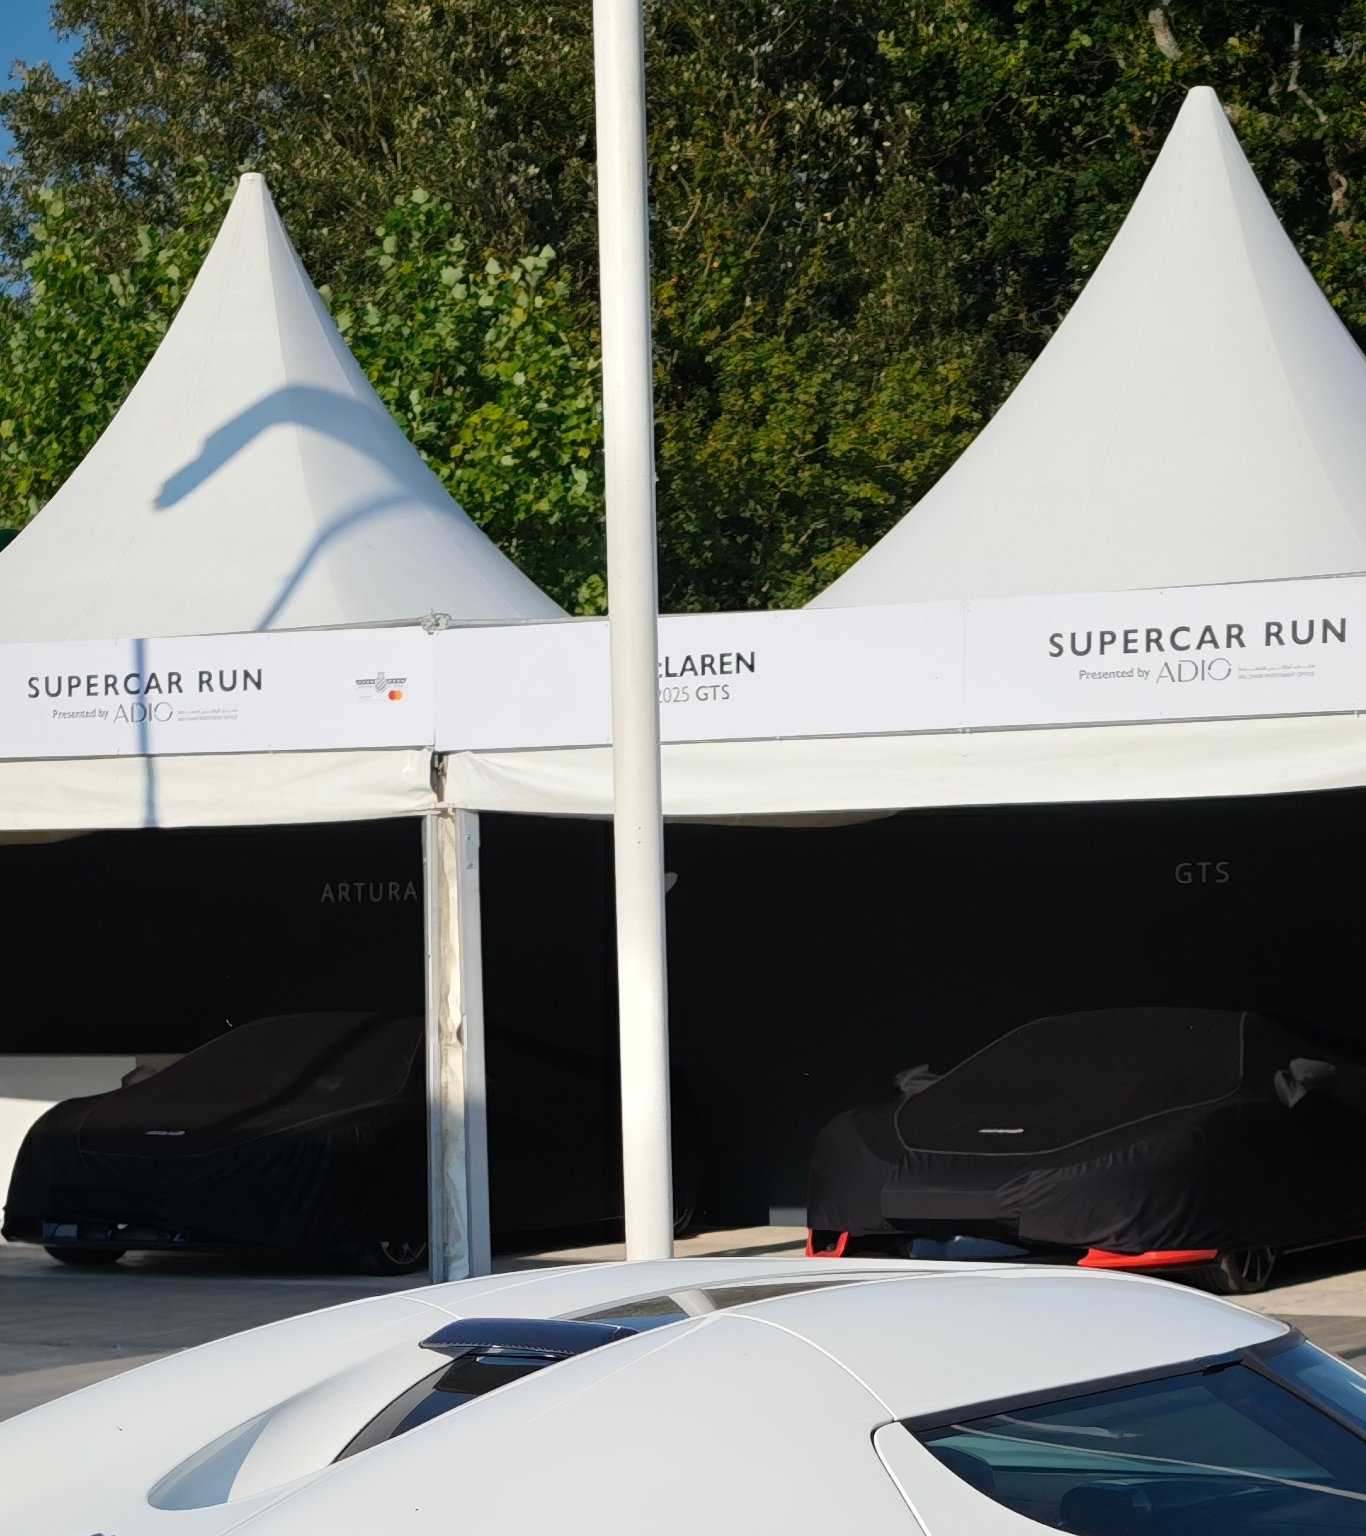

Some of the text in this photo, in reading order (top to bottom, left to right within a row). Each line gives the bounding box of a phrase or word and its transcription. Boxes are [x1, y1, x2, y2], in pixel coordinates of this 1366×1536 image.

[1048, 616, 1347, 658] SUPERCAR RUN
[1078, 666, 1135, 682] Presented
[1137, 665, 1152, 681] by
[1156, 657, 1232, 684] ADIO
[27, 668, 263, 699] SUPERCAR RUN
[695, 684, 730, 702] GTS
[51, 707, 96, 724] Presented
[97, 708, 110, 725] by
[112, 701, 174, 724] ADIO
[1174, 861, 1230, 884] GTS
[320, 880, 419, 904] ARTURA
